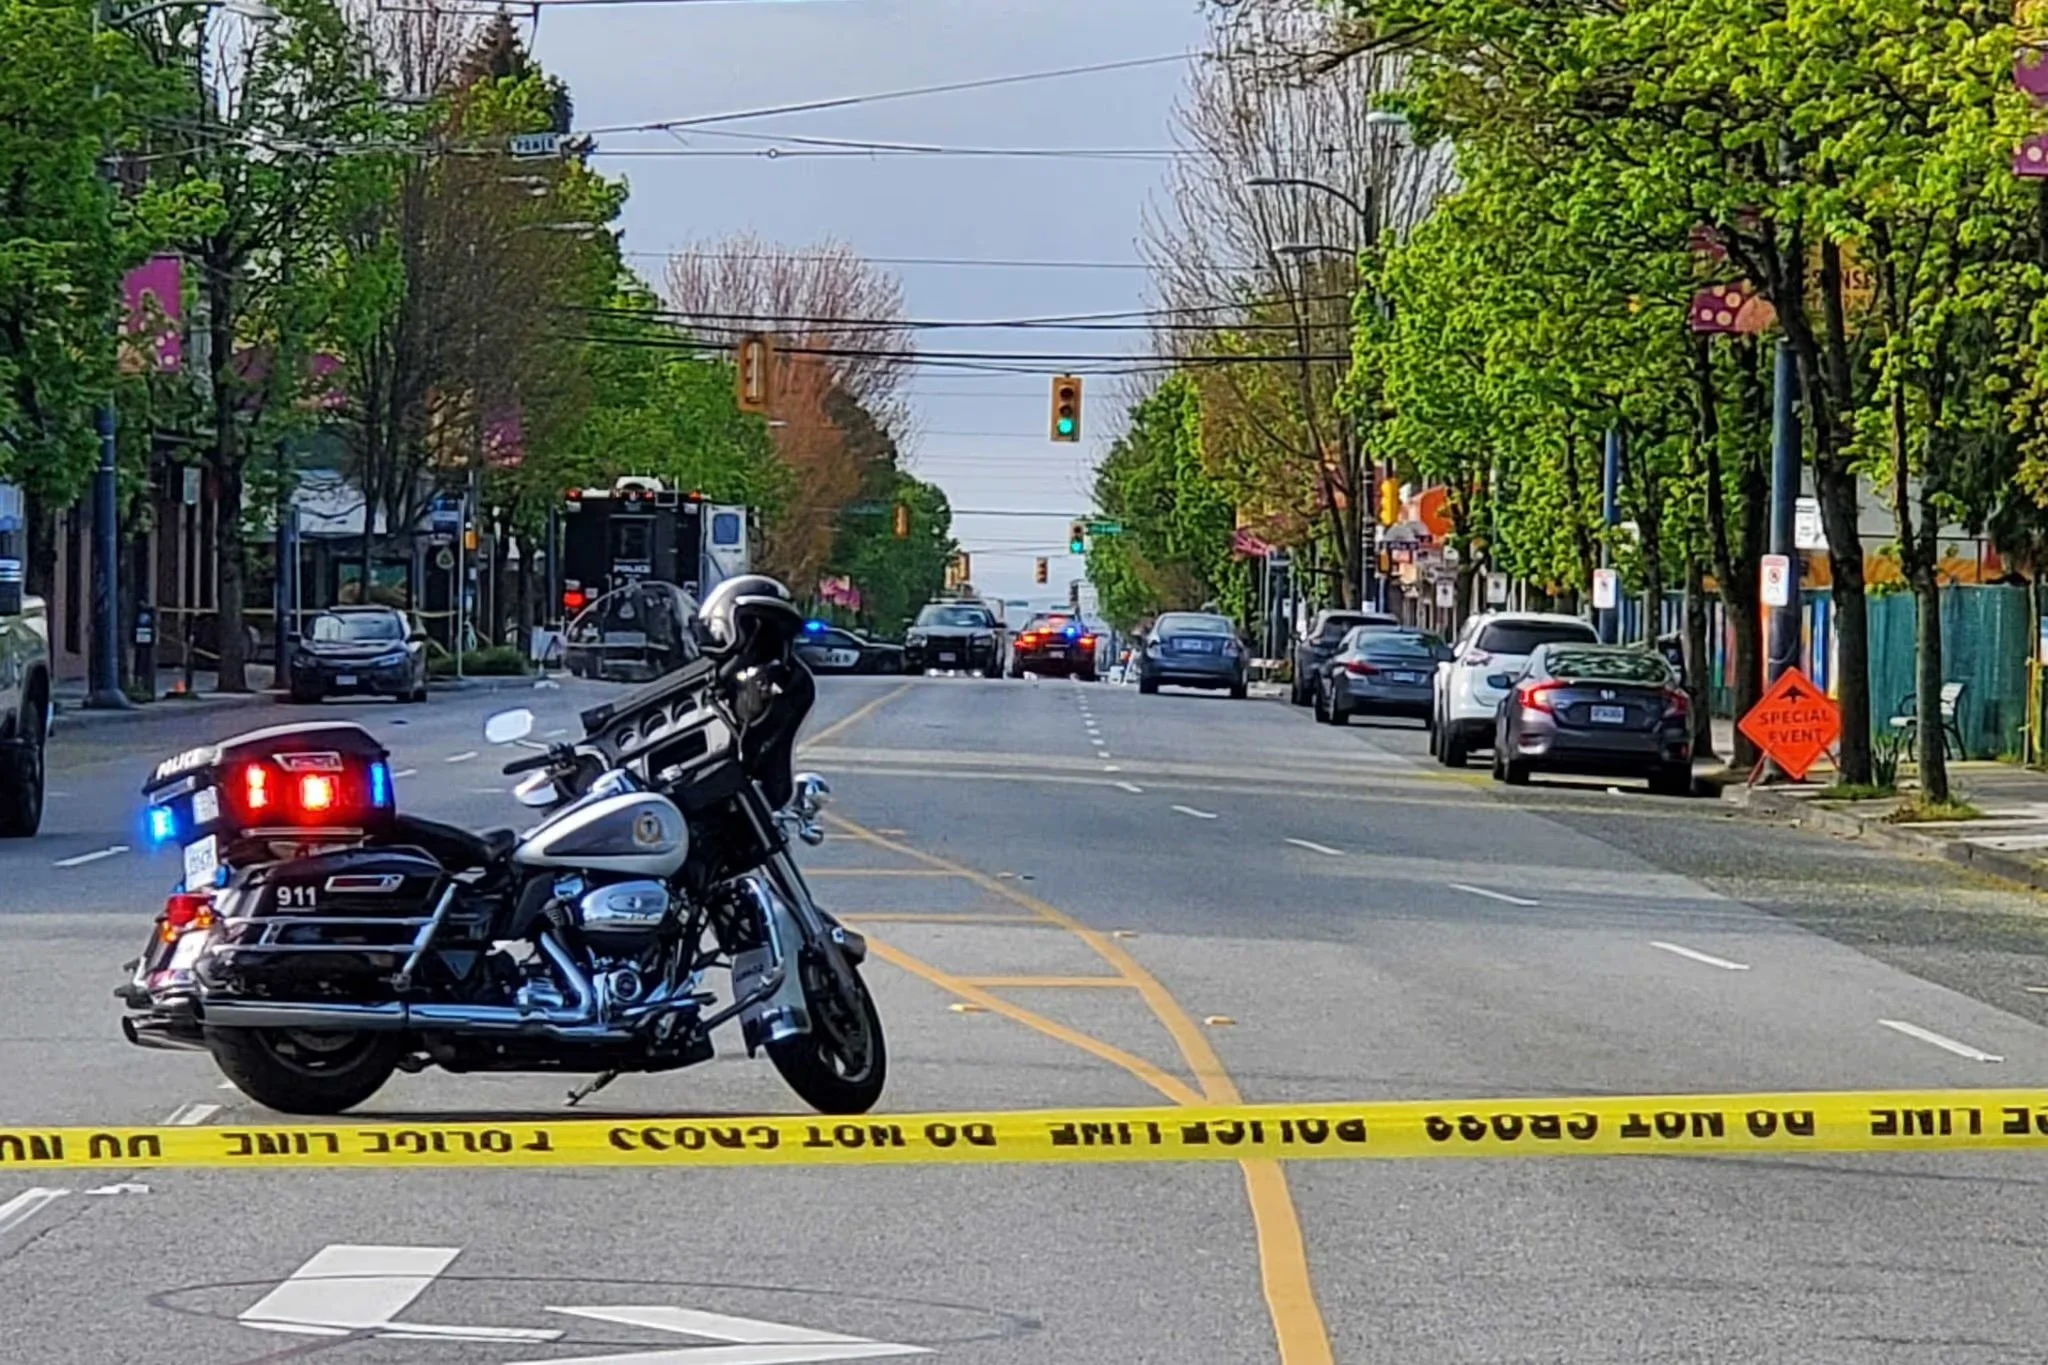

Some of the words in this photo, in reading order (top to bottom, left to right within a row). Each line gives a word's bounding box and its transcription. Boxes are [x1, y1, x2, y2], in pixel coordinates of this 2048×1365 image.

[1759, 709, 1828, 726] SPECIAL
[1768, 728, 1824, 743] EVENT
[156, 748, 200, 781] POLICE
[276, 886, 317, 906] 911
[1051, 1122, 1162, 1146] LINE
[1181, 1119, 1367, 1146] POLICE
[1425, 1114, 1598, 1142] CROSS
[1620, 1111, 1725, 1140] NOT
[1746, 1110, 1815, 1138] DO
[1871, 1108, 1982, 1136] LINE
[223, 1132, 339, 1156] LINE
[359, 1130, 553, 1154] POLICE
[609, 1126, 779, 1151] CROSS
[803, 1124, 906, 1149] NOT
[924, 1123, 997, 1148] DO
